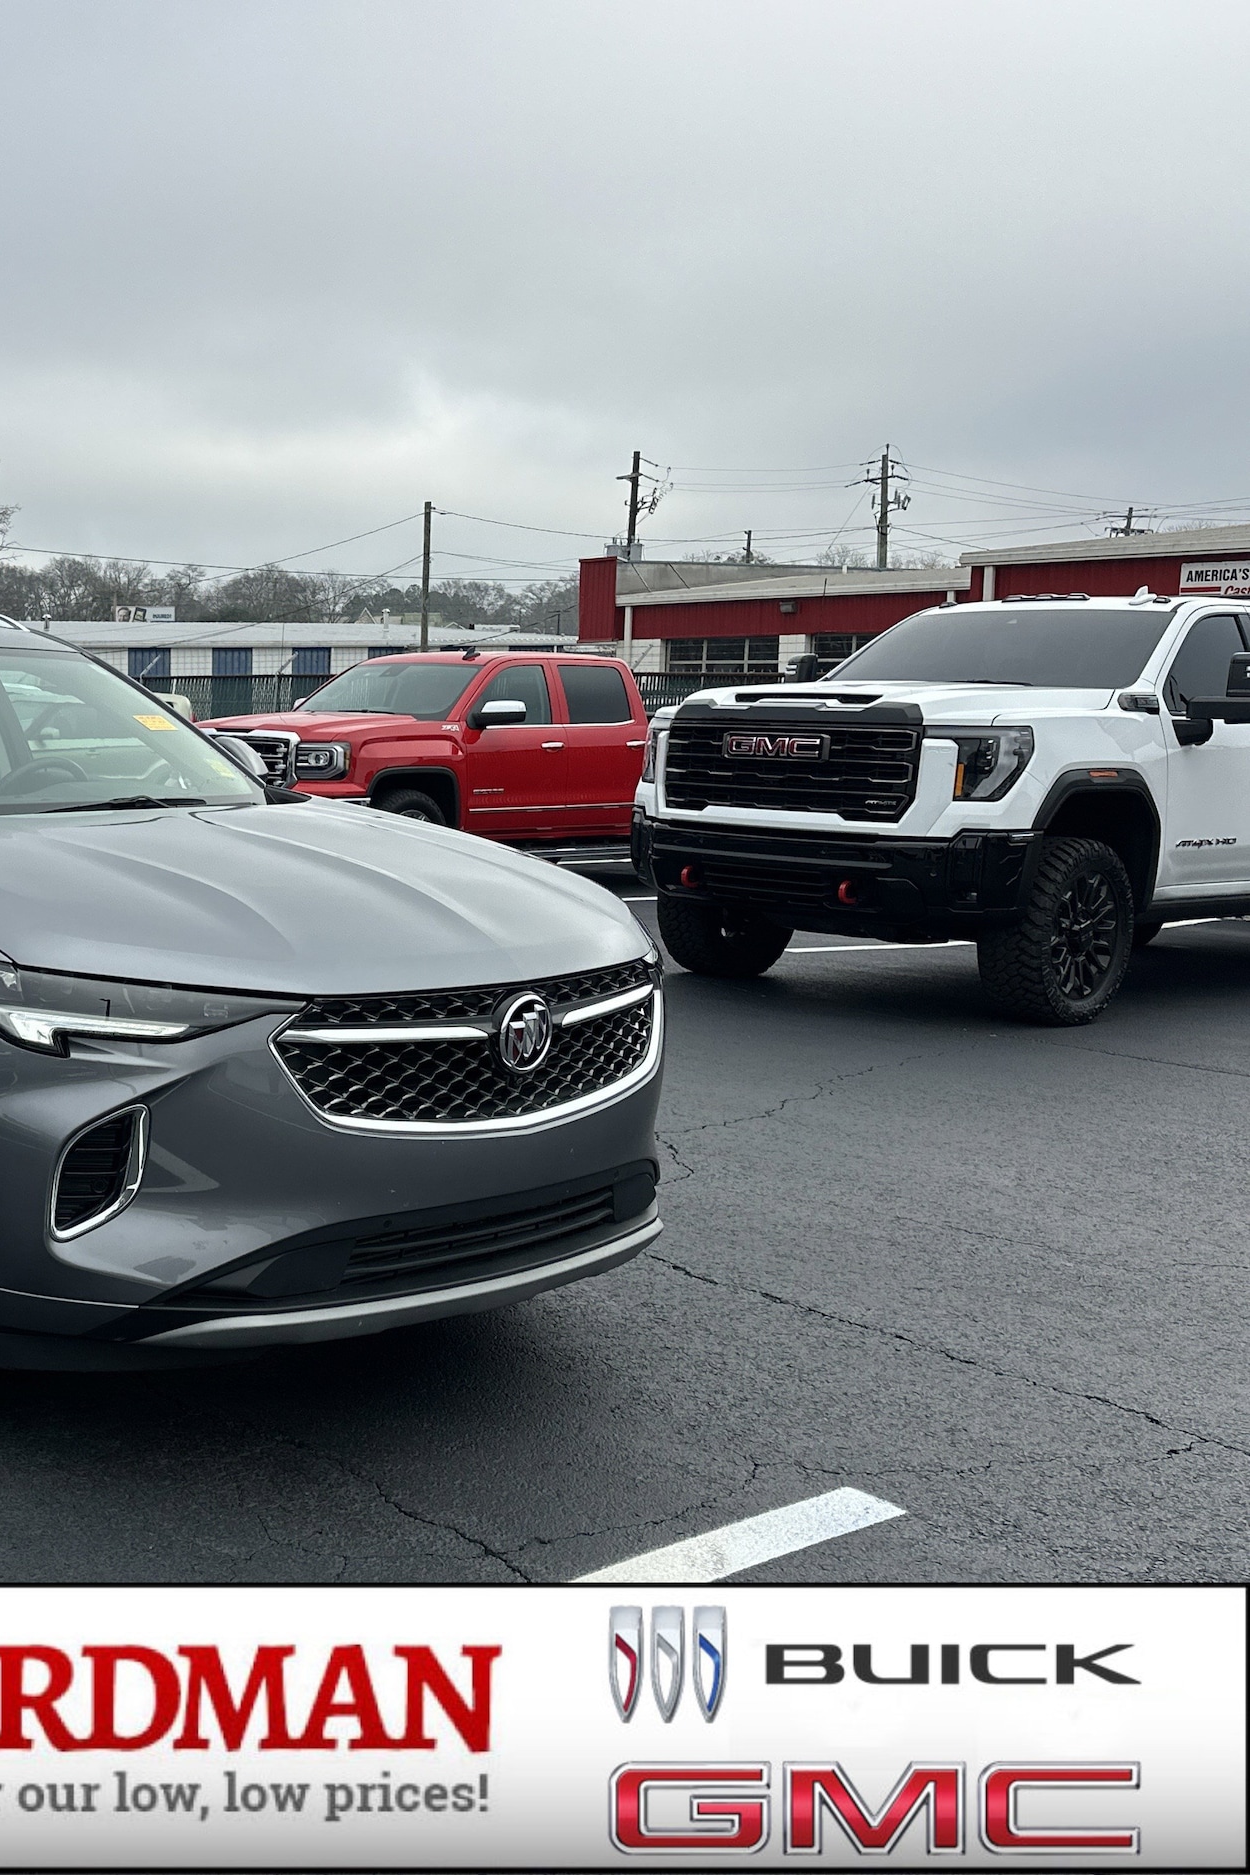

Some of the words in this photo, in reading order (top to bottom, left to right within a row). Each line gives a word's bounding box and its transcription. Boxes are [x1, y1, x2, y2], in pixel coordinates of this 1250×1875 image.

[1186, 568, 1250, 582] AMERICA'S
[728, 736, 820, 757] GMC
[1215, 837, 1237, 846] HD
